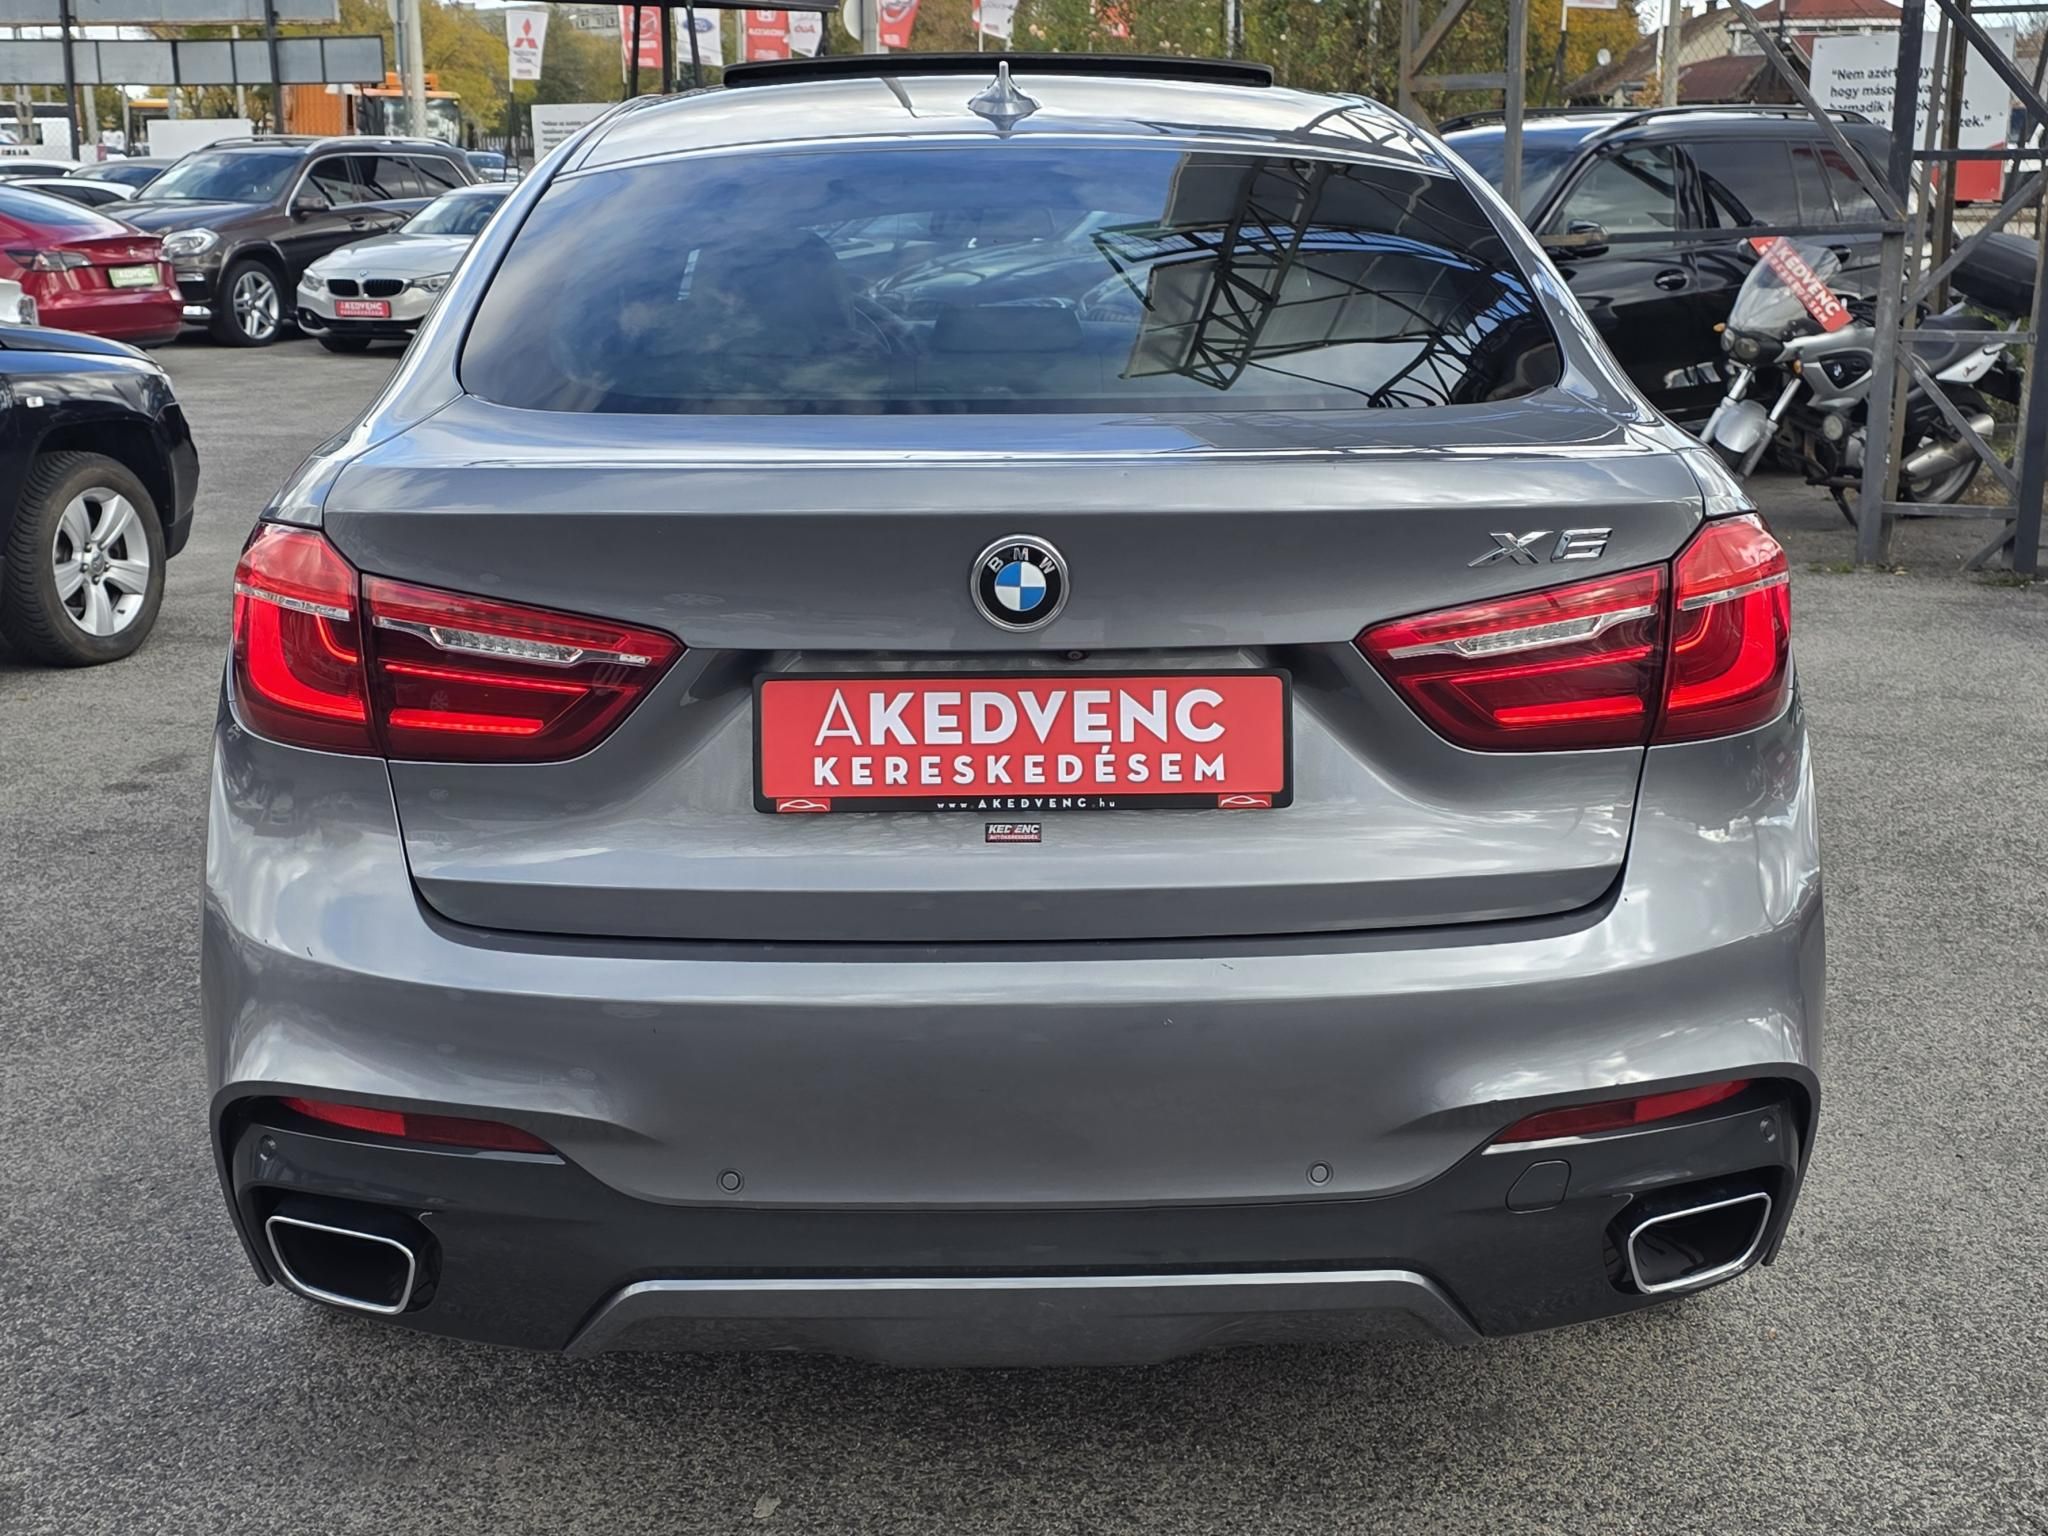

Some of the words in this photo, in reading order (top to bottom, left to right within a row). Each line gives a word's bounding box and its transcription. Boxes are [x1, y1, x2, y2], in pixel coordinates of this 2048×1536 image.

[987, 547, 1056, 575] BMW
[1467, 527, 1613, 567] X6
[814, 688, 1225, 746] AKEDVENC
[814, 745, 1226, 786] KERESKEDÉSEM
